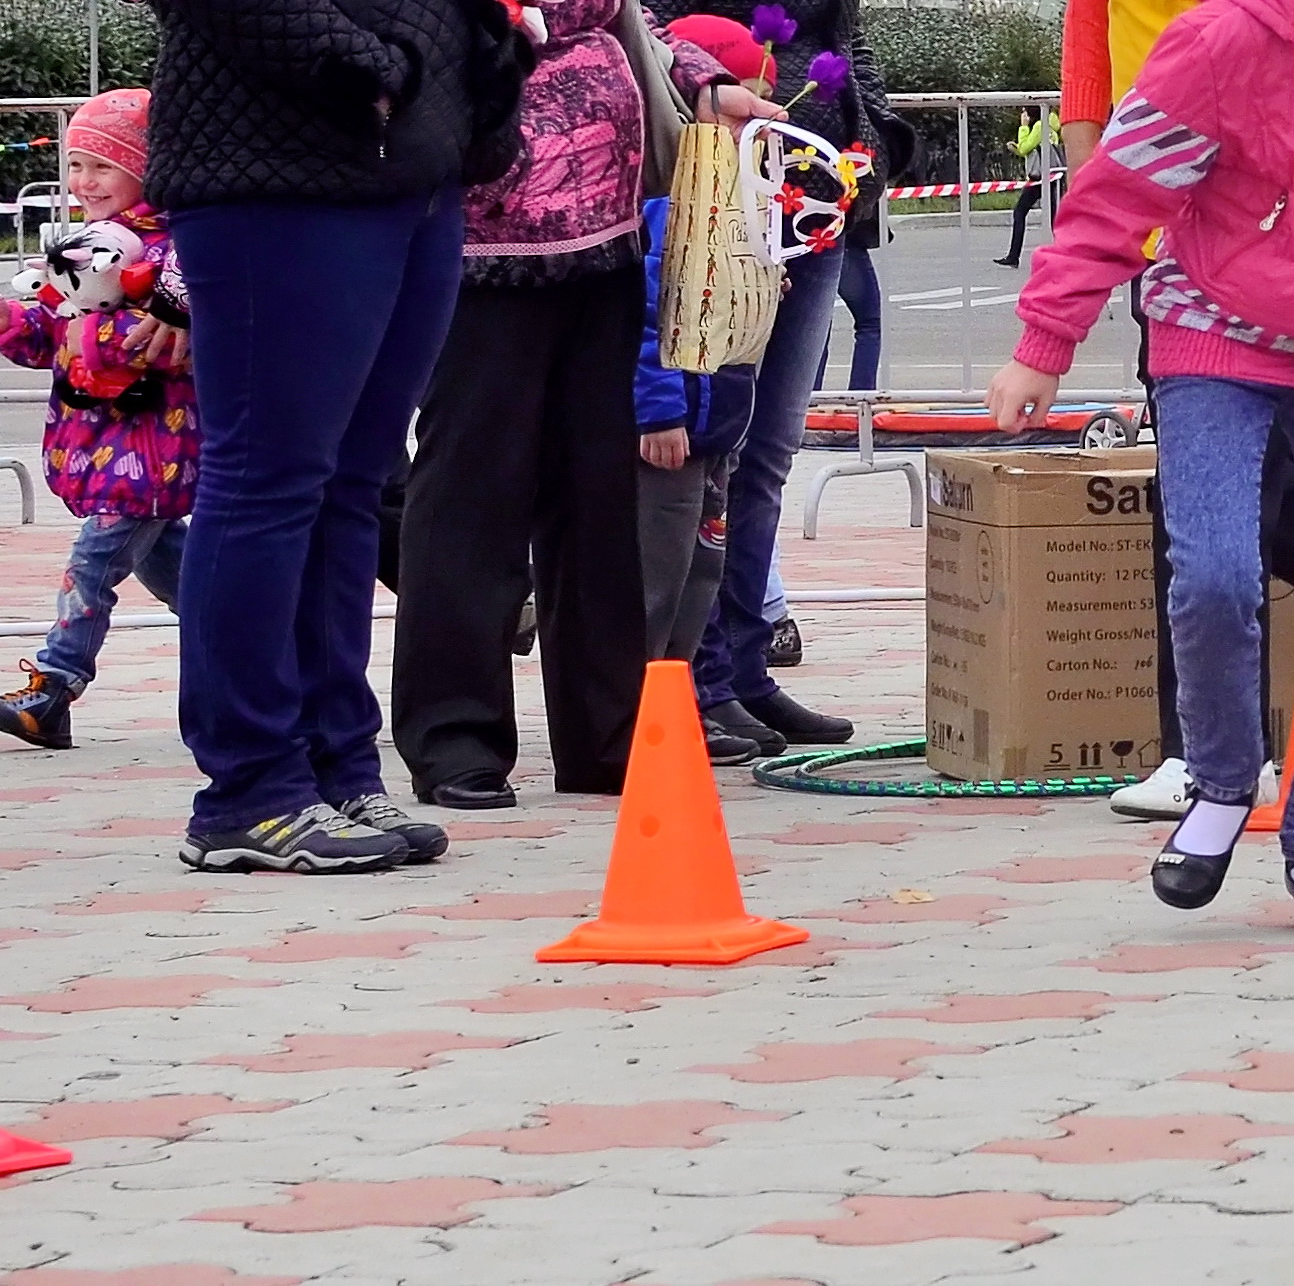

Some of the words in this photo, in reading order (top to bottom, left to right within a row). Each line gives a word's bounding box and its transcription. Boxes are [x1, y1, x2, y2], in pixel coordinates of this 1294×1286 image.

[1046, 540, 1086, 553] Model
[1089, 540, 1114, 552] No.:
[1116, 539, 1154, 552] ST-EK
[1046, 570, 1106, 585] Quantity:
[1115, 569, 1129, 581] 12
[1046, 599, 1136, 612] Measurement:
[1046, 629, 1091, 644] Weight
[1046, 659, 1089, 671] Carton
[1092, 659, 1118, 670] No.:
[1046, 690, 1083, 701] Order
[1086, 688, 1111, 700] No.:
[1050, 742, 1064, 764] 5
